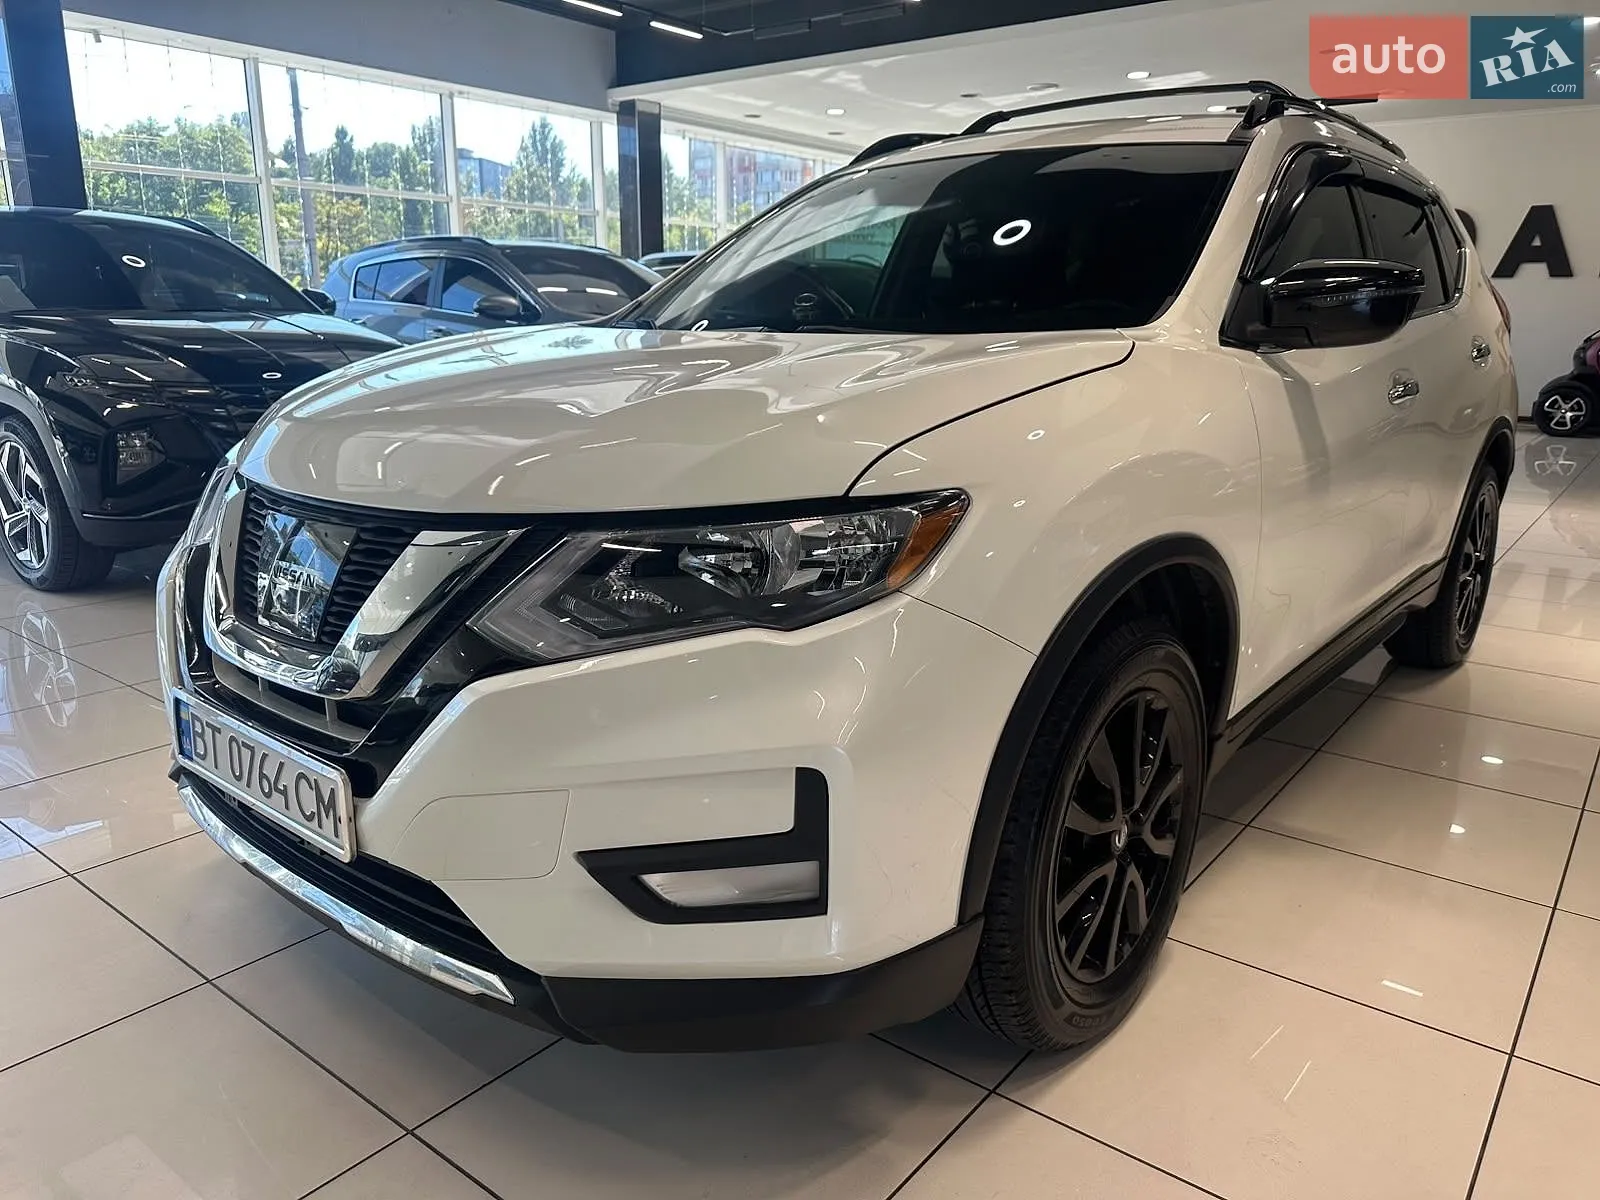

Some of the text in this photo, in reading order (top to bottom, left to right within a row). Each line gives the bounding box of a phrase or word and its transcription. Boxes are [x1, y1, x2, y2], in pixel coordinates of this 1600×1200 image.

[273, 565, 316, 588] NISSAN
[191, 711, 339, 839] BT 0764 CM
